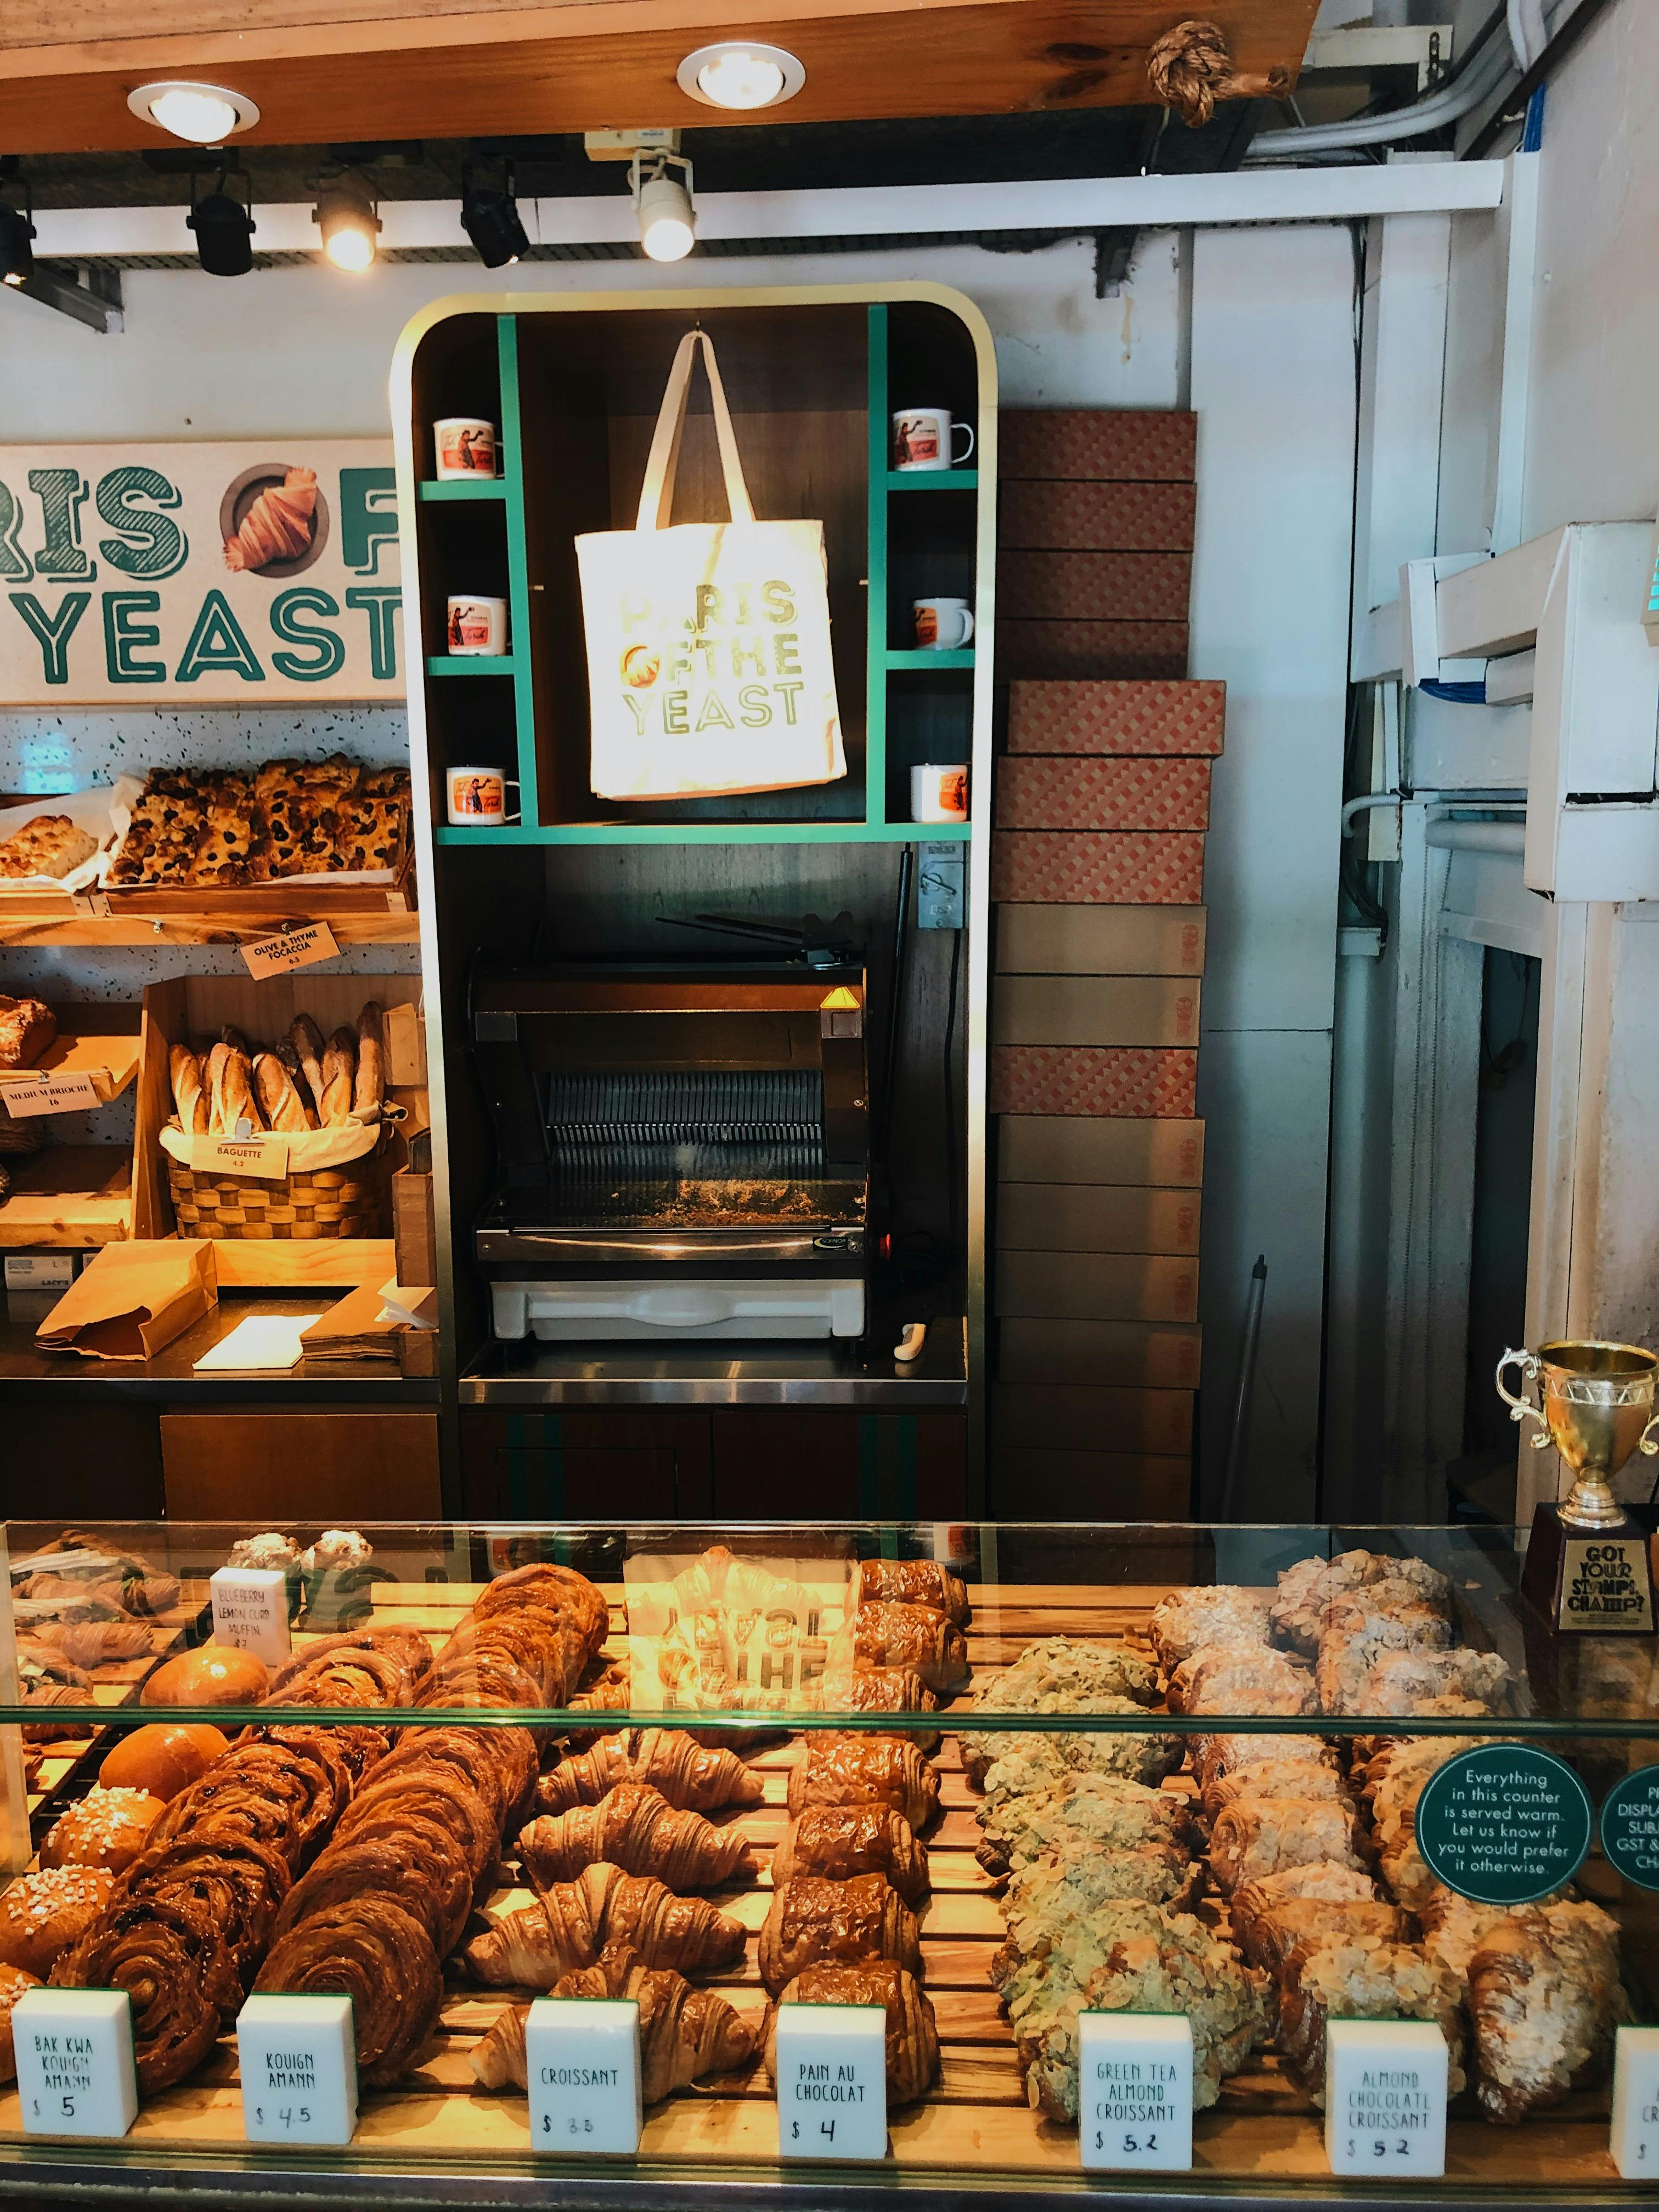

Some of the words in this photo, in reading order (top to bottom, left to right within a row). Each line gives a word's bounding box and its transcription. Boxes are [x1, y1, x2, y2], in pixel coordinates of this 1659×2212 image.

[8, 586, 403, 684] YEAST
[622, 681, 804, 736] YEAST
[255, 942, 279, 956] OLIVE
[289, 930, 318, 945] THYME
[268, 941, 312, 960] FOCACCIA
[10, 1088, 48, 1101] MEDIUM
[49, 1085, 88, 1096] BRIOCHE
[217, 1147, 262, 1159] BAGUETTE
[1585, 1545, 1626, 1562] GOT
[1579, 1562, 1633, 1578] YOUR
[218, 1588, 264, 1603] BLUEBERRY
[1567, 1595, 1645, 1612] CHAMP?
[219, 1607, 246, 1620] LEMON
[228, 1624, 261, 1637] MUFFIN
[1466, 1769, 1547, 1789] Everything
[1452, 1788, 1465, 1801] in
[1472, 1786, 1498, 1802] this
[1503, 1791, 1561, 1804] counter
[1444, 1805, 1455, 1818] is
[1461, 1805, 1512, 1820] served
[1517, 1810, 1565, 1821] warm.
[1453, 1822, 1474, 1836] Let
[1479, 1826, 1494, 1837] us
[1500, 1823, 1541, 1838] know
[1547, 1824, 1558, 1839] if
[1438, 1843, 1466, 1857] you
[1471, 1841, 1518, 1856] would
[1523, 1841, 1570, 1860] prefer
[1616, 1838, 1646, 1852] GST
[1455, 1858, 1466, 1871] it
[1470, 1858, 1550, 1875] otherwise.
[35, 2036, 58, 2053] BAK
[66, 2037, 93, 2054] KWA
[266, 2053, 314, 2070] KOUIGN
[269, 2072, 315, 2090] AMANN
[541, 2068, 618, 2086] CROISSANT
[800, 2064, 829, 2081] PAIN
[838, 2065, 854, 2082] AU
[1097, 2063, 1141, 2080] GREEN
[1150, 2063, 1177, 2081] TEA
[1362, 2071, 1419, 2088] ALMOND
[796, 2084, 865, 2102] CHOCOLAT
[1109, 2084, 1164, 2102] ALMOND
[1349, 2090, 1431, 2110] CHOCOLATE
[61, 2096, 75, 2117] 5
[1097, 2103, 1176, 2122] CROISSANT
[279, 2107, 311, 2129] 4.5
[1349, 2111, 1430, 2130] CROISSANT
[792, 2120, 799, 2140] $
[821, 2119, 835, 2142] 4
[1096, 2131, 1103, 2150] $
[1124, 2134, 1158, 2152] 5.2
